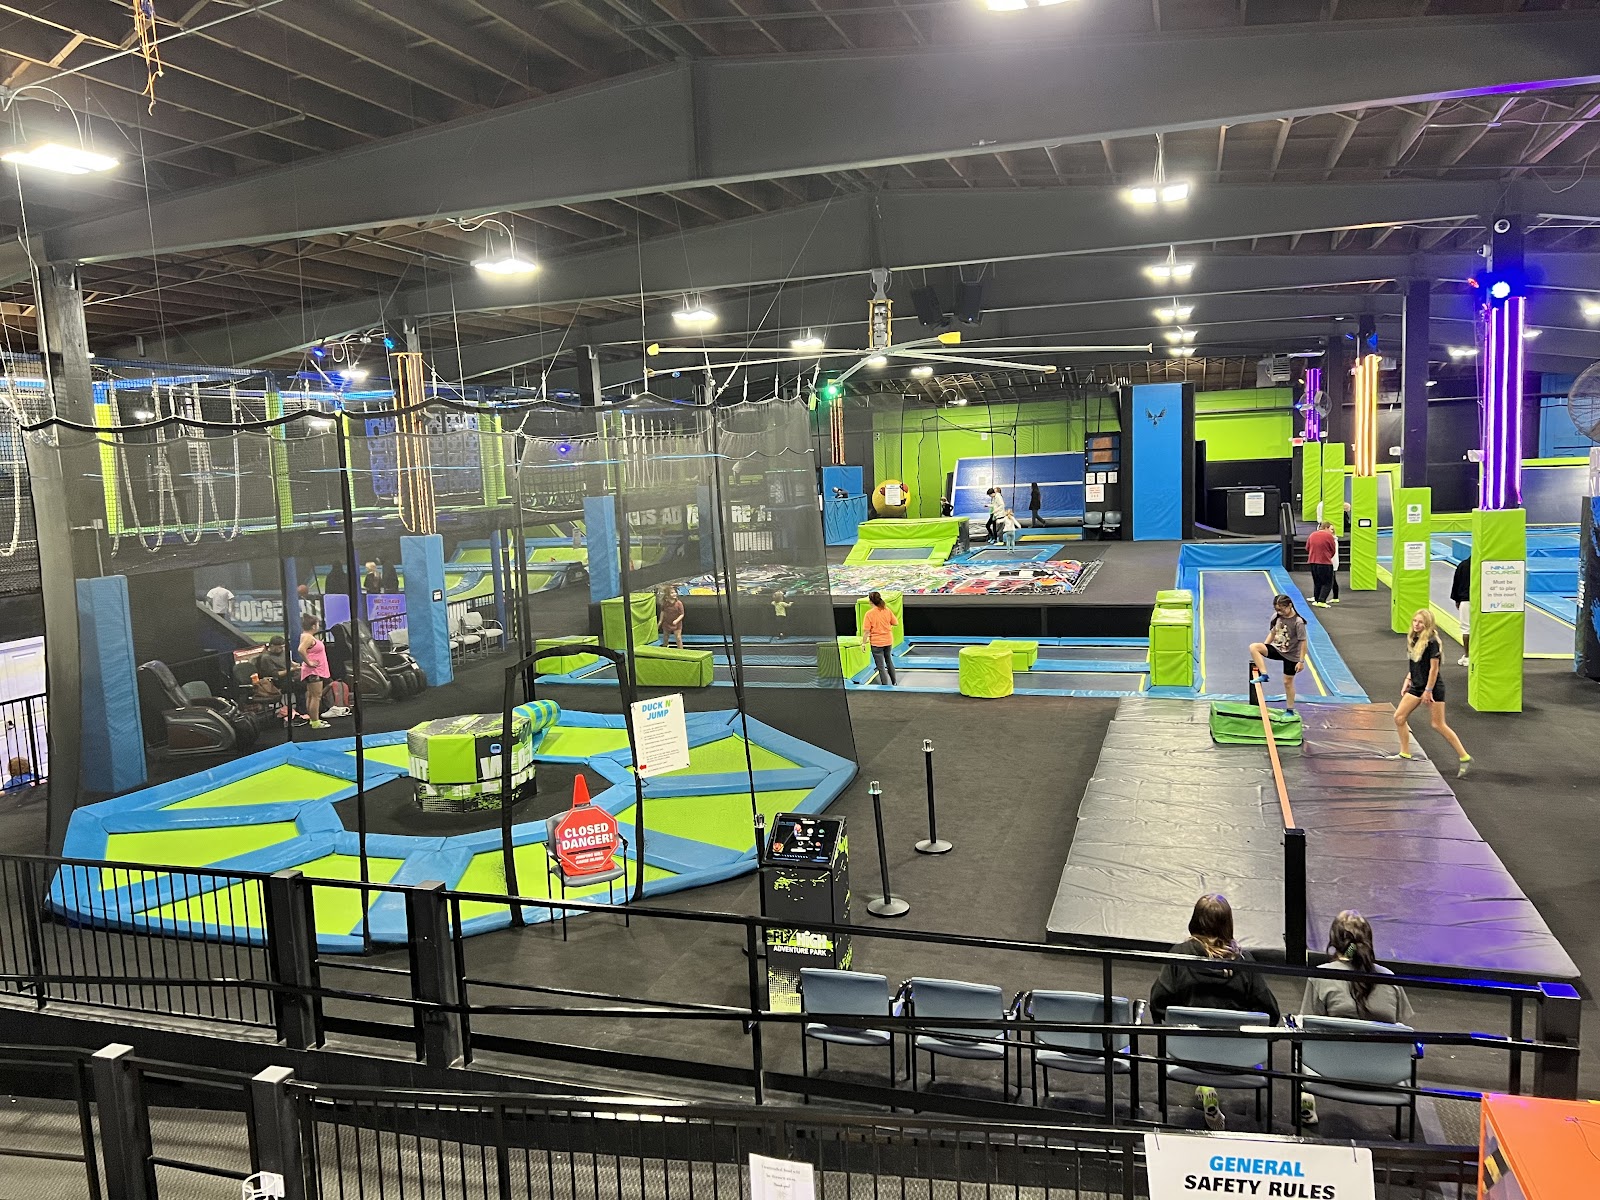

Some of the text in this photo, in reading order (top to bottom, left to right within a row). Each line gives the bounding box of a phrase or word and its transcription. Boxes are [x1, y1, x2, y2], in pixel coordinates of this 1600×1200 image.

[641, 701, 663, 713] DUCK
[646, 709, 669, 721] JUMP
[564, 822, 609, 839] CLOSED
[561, 833, 614, 850] DANGER!
[773, 929, 798, 945] FLY
[773, 945, 827, 957] ADVENTURE PARK
[1209, 1155, 1305, 1177] GENERAL
[1184, 1175, 1336, 1200] SAFETY RULES
